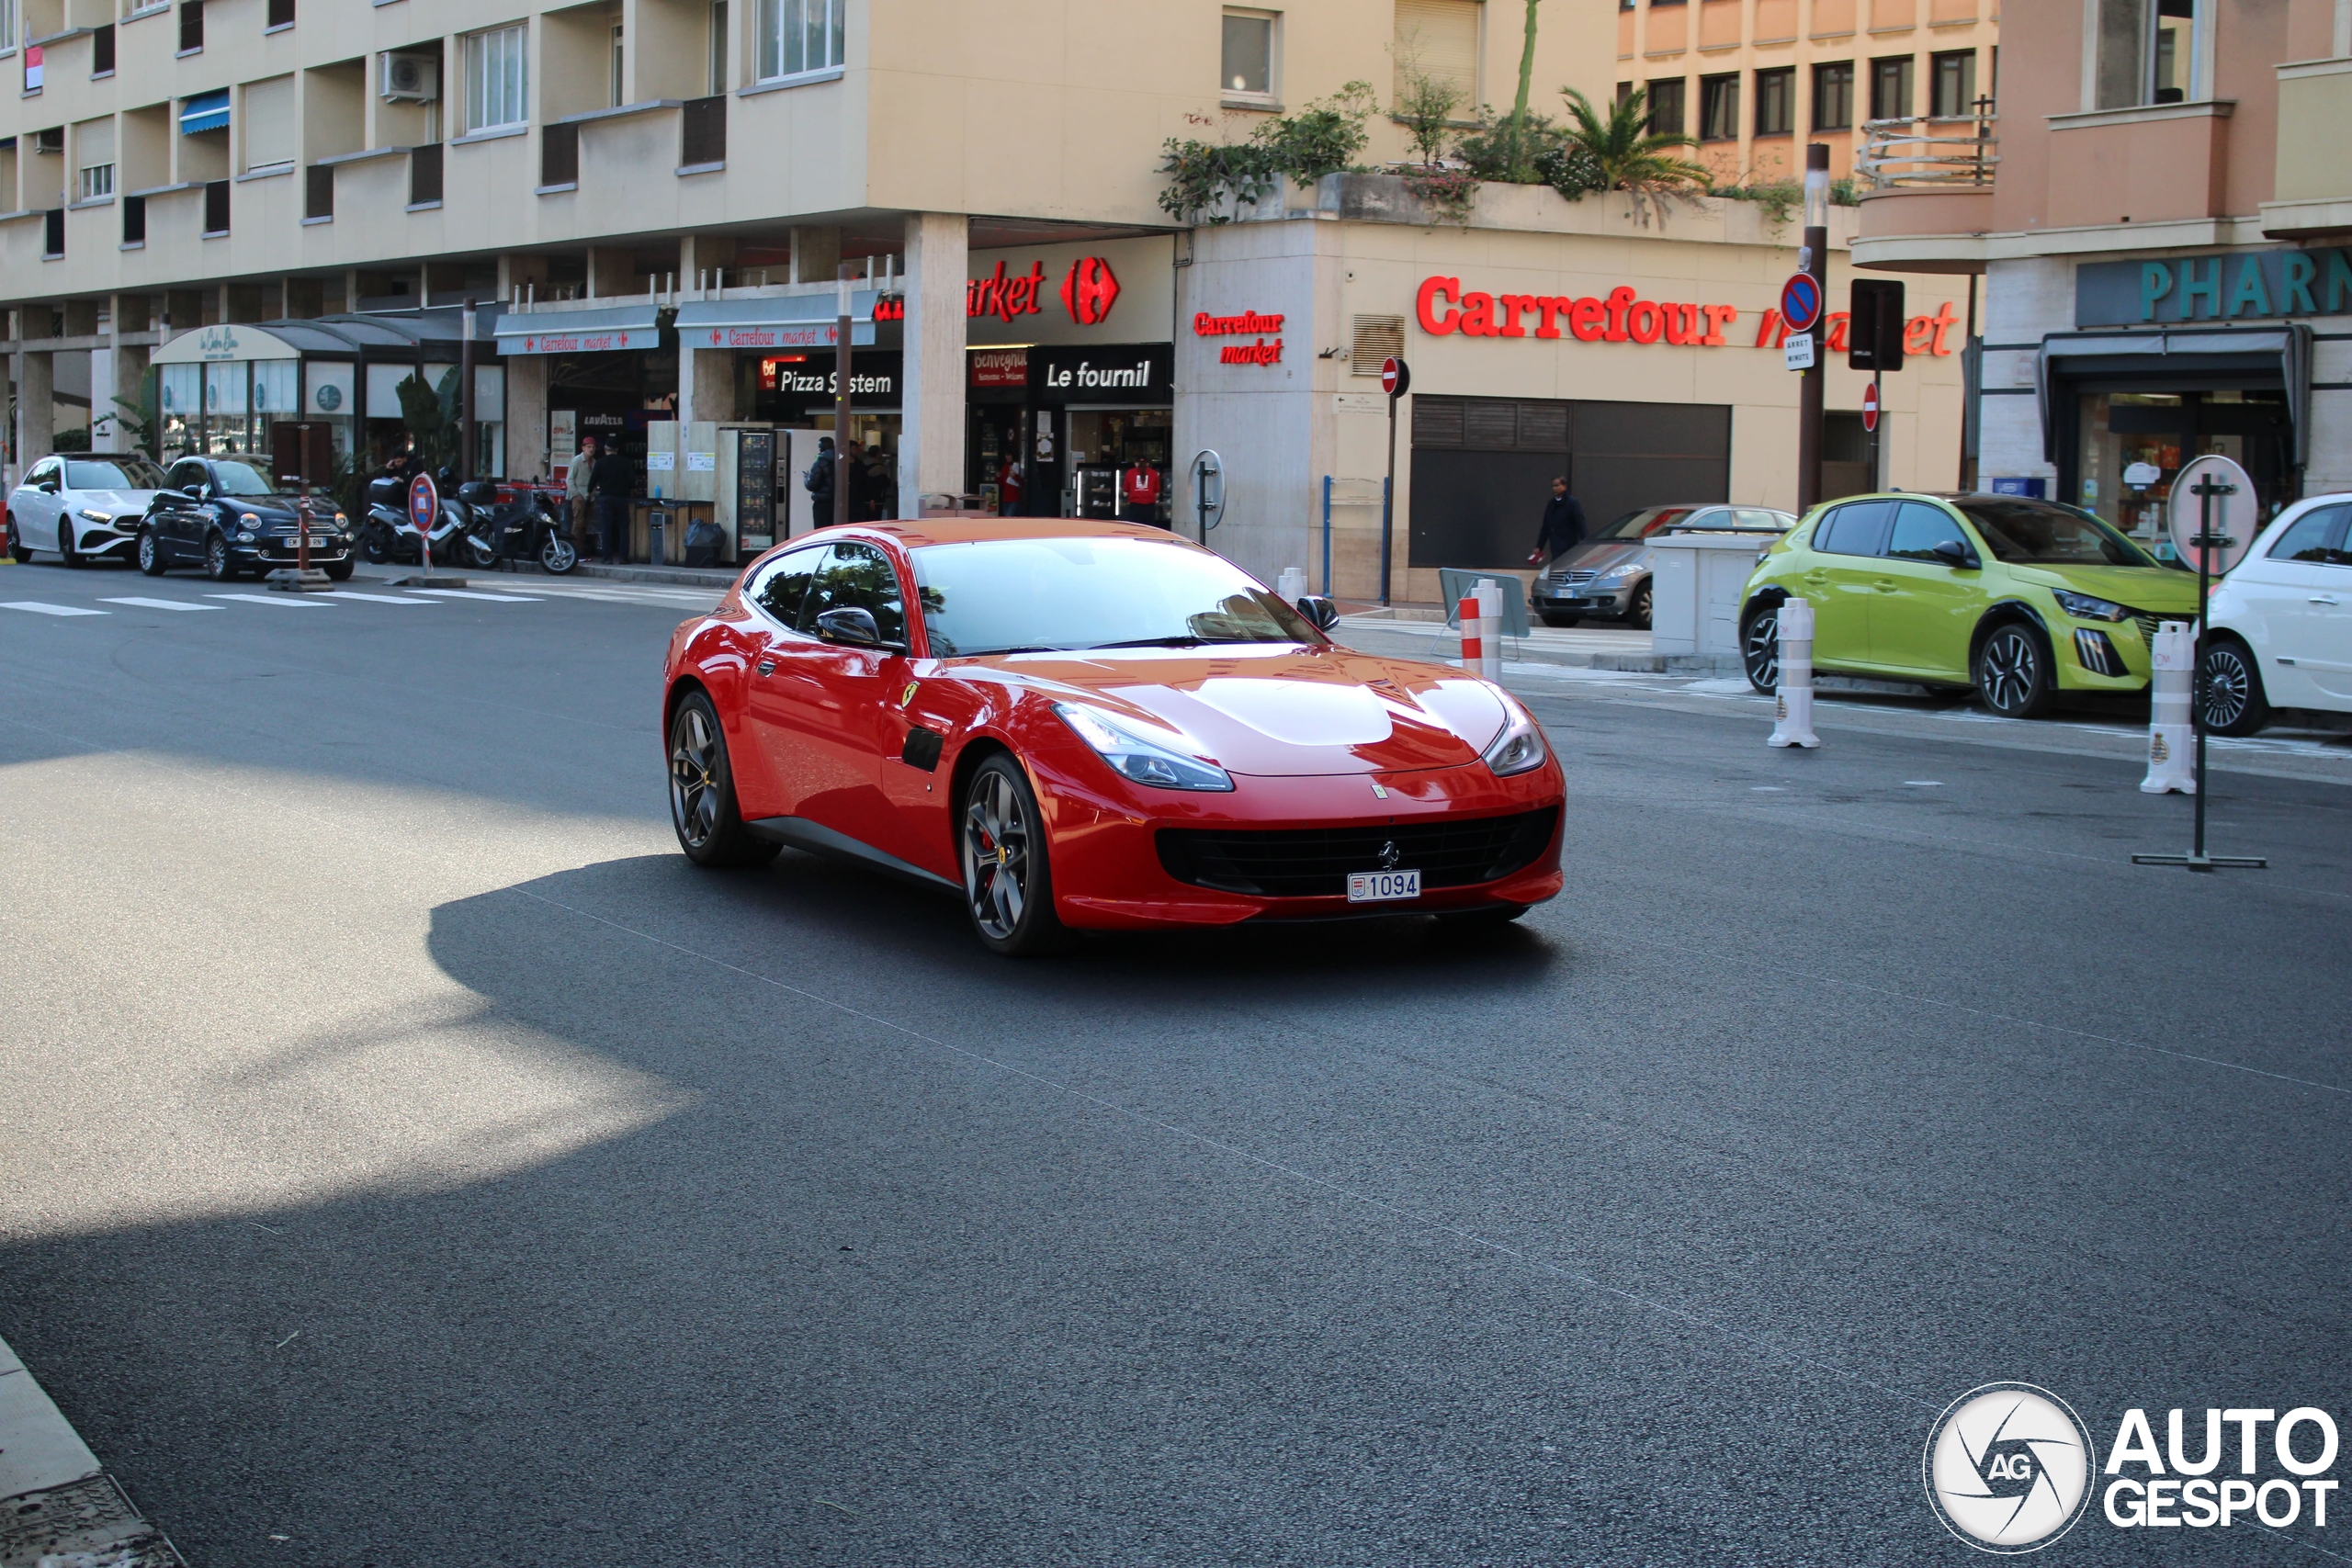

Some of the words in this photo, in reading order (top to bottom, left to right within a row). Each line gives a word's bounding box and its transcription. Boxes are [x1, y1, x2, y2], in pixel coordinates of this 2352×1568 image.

[967, 261, 1046, 323] arket
[1416, 276, 1736, 346] Carrefour
[1193, 310, 1284, 336] Carrefour
[540, 333, 578, 352] Carrefour
[583, 334, 612, 351] market
[729, 327, 775, 346] Carrefour
[782, 327, 817, 346] market
[1787, 339, 1808, 349] ARRET
[1219, 338, 1283, 367] market
[1788, 353, 1809, 363] MINUTE
[781, 370, 825, 392] Pizza
[828, 371, 891, 394] Sstem
[1046, 364, 1072, 388] Le
[1076, 360, 1151, 388] fournil
[583, 413, 624, 425] LAVAZZA
[1370, 874, 1417, 897] 1094
